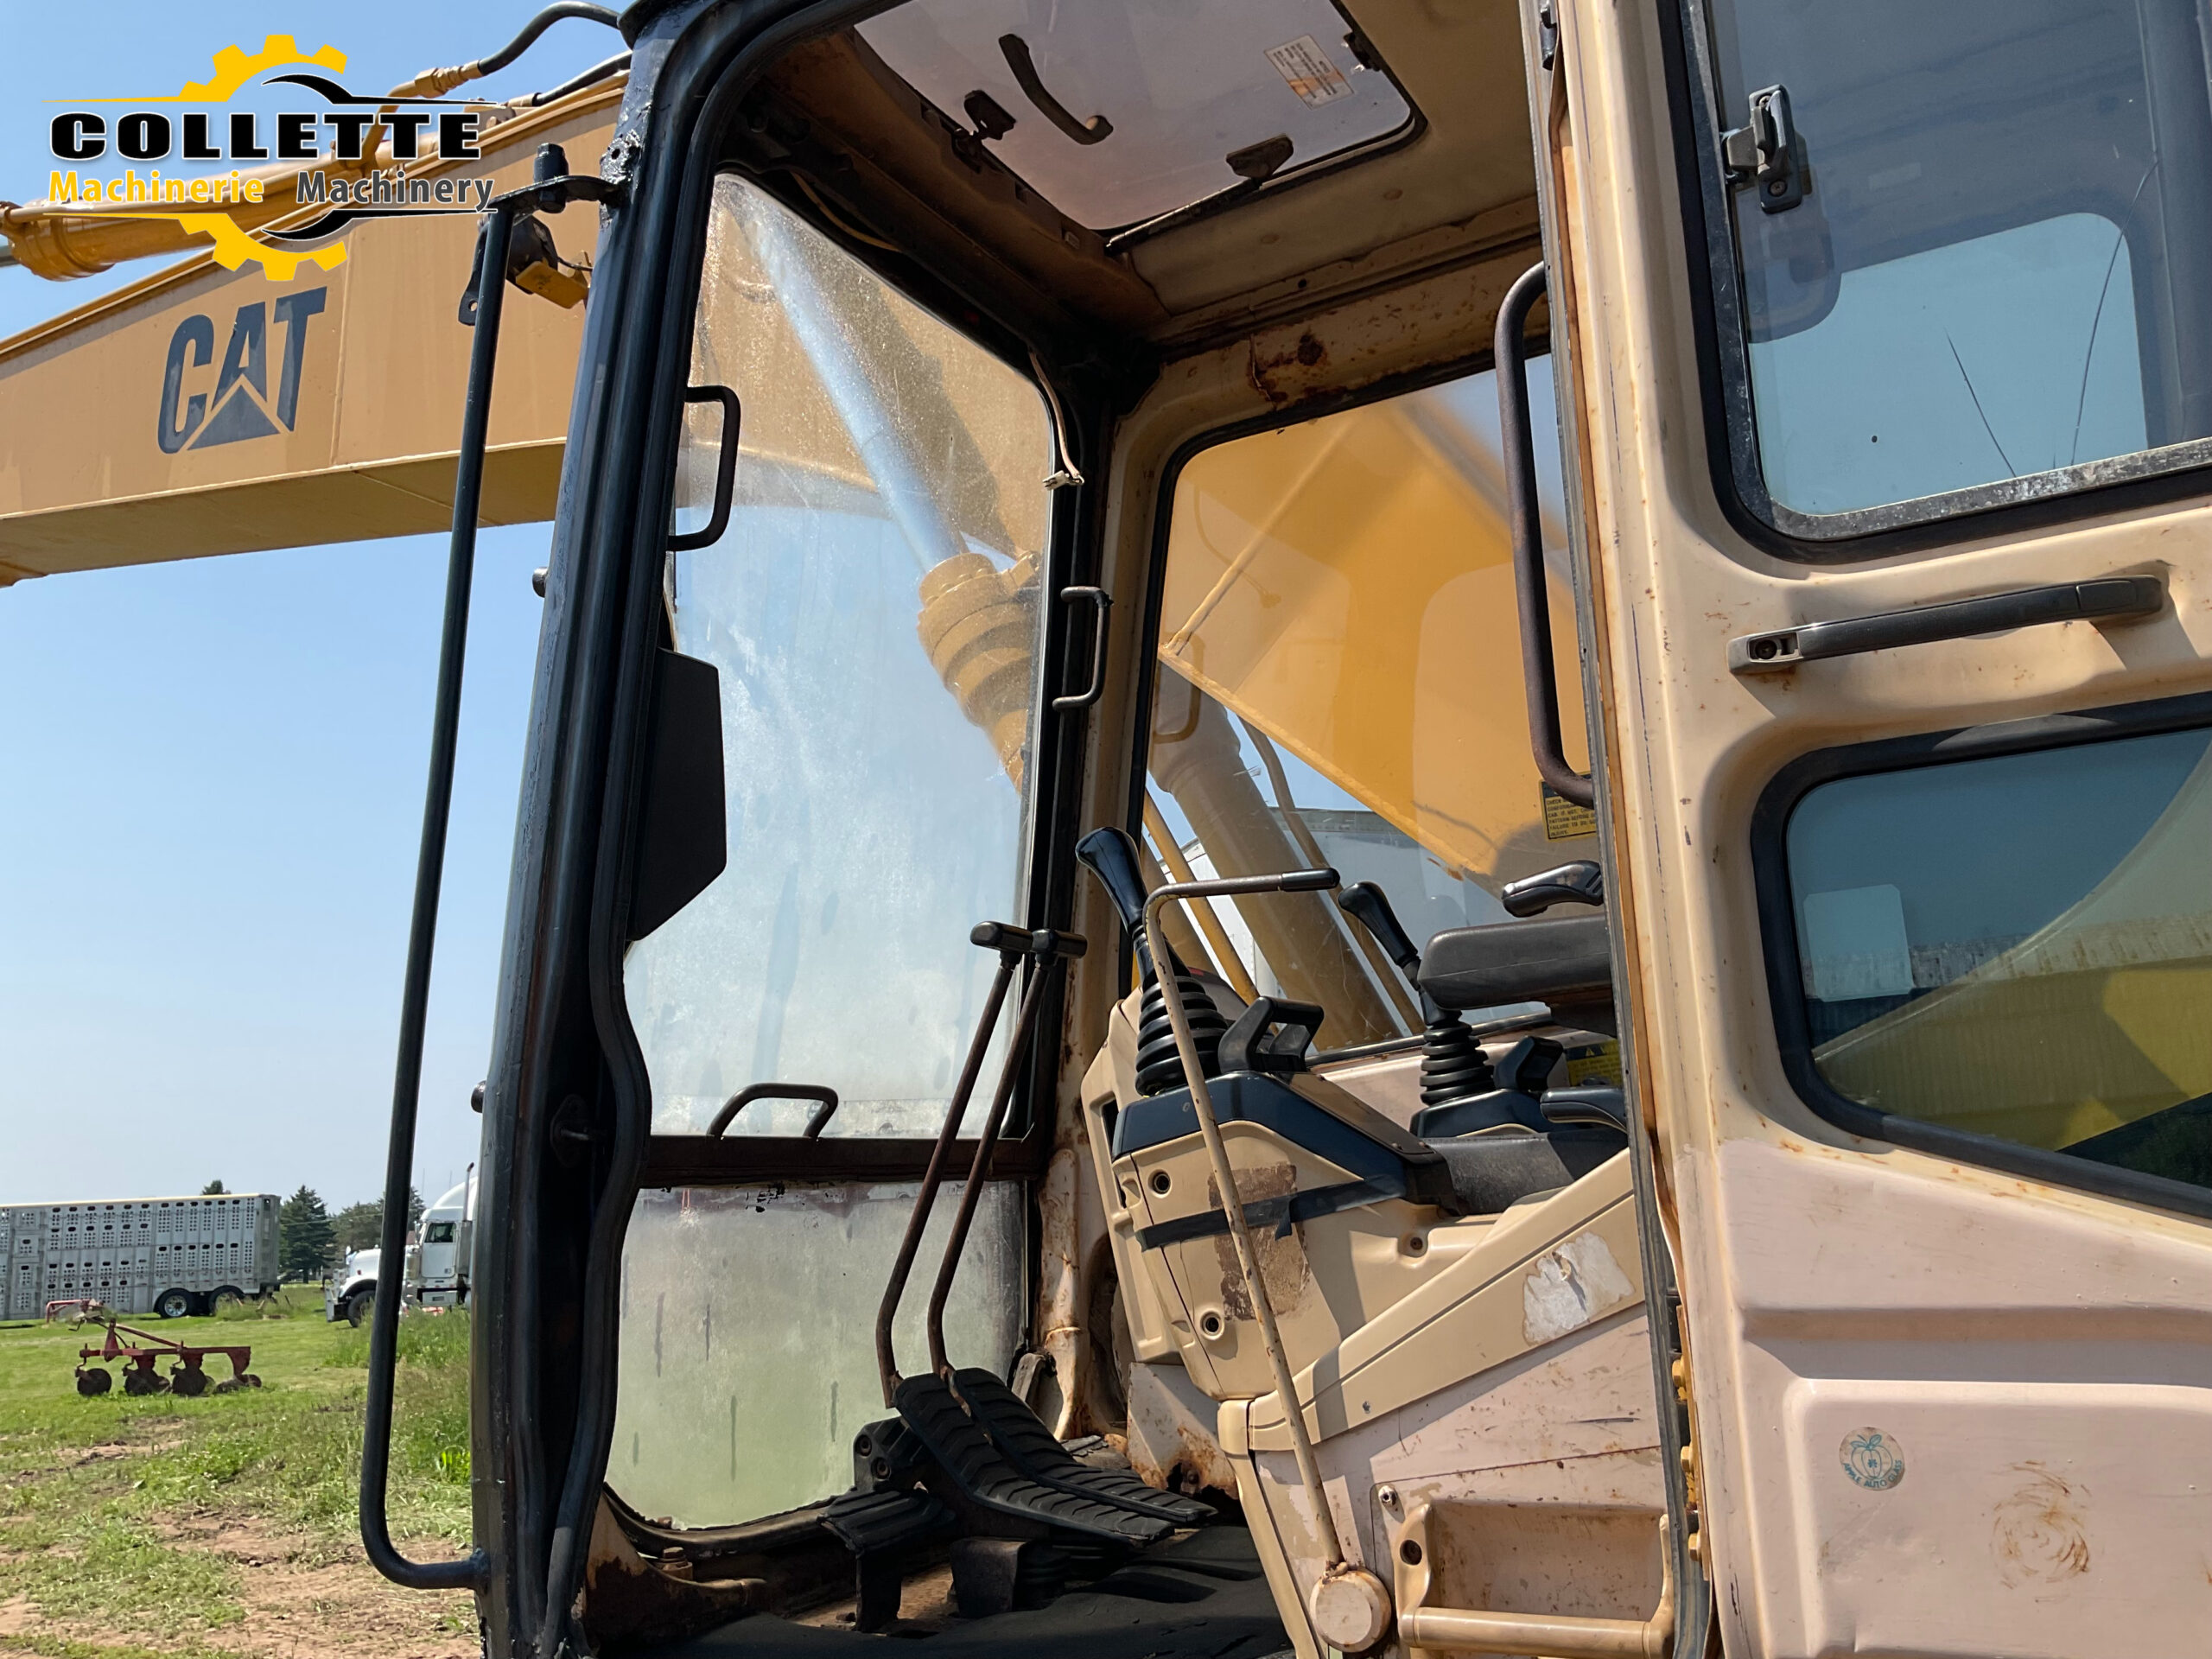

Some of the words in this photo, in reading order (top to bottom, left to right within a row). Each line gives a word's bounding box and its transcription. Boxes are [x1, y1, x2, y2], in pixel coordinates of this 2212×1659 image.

[157, 286, 327, 454] CAT
[1842, 1462, 1862, 1484] APPLE
[1864, 1479, 1888, 1488] AUTO
[1888, 1459, 1902, 1483] GLASS
